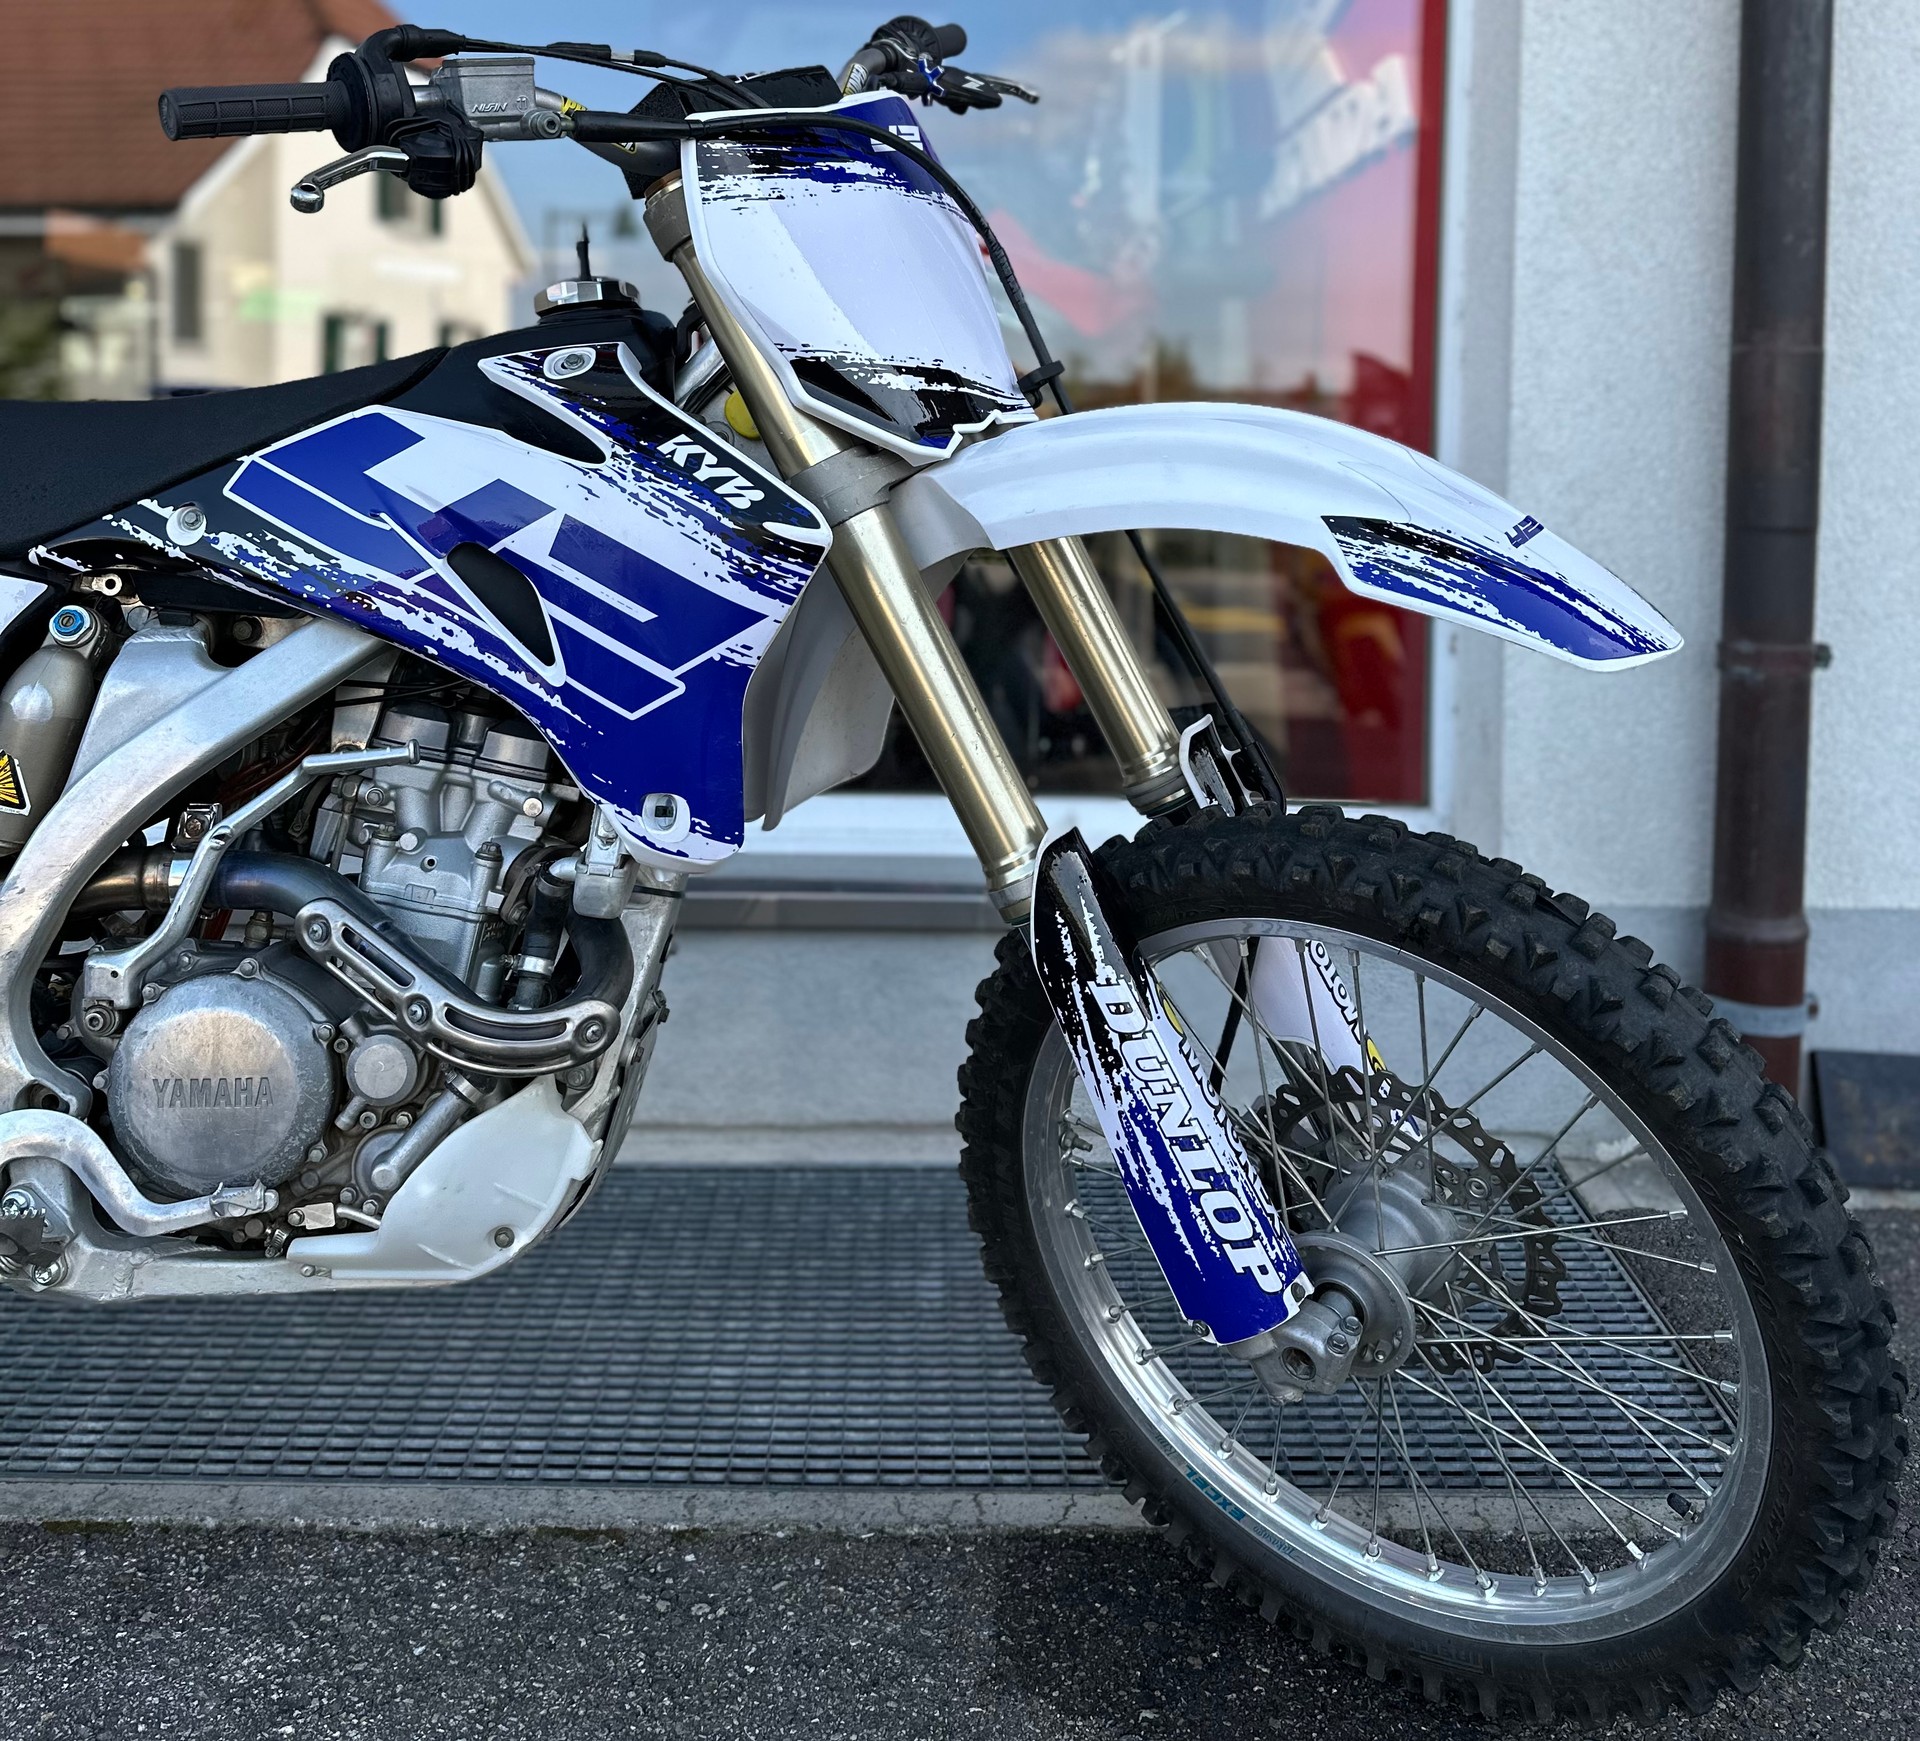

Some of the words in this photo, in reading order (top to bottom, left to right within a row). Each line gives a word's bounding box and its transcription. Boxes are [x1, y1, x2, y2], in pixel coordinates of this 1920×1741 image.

[656, 434, 765, 509] KYB
[152, 1076, 273, 1108] YAMAHA
[1087, 979, 1283, 1294] DUNLOP
[1184, 1464, 1246, 1521] EXCEL
